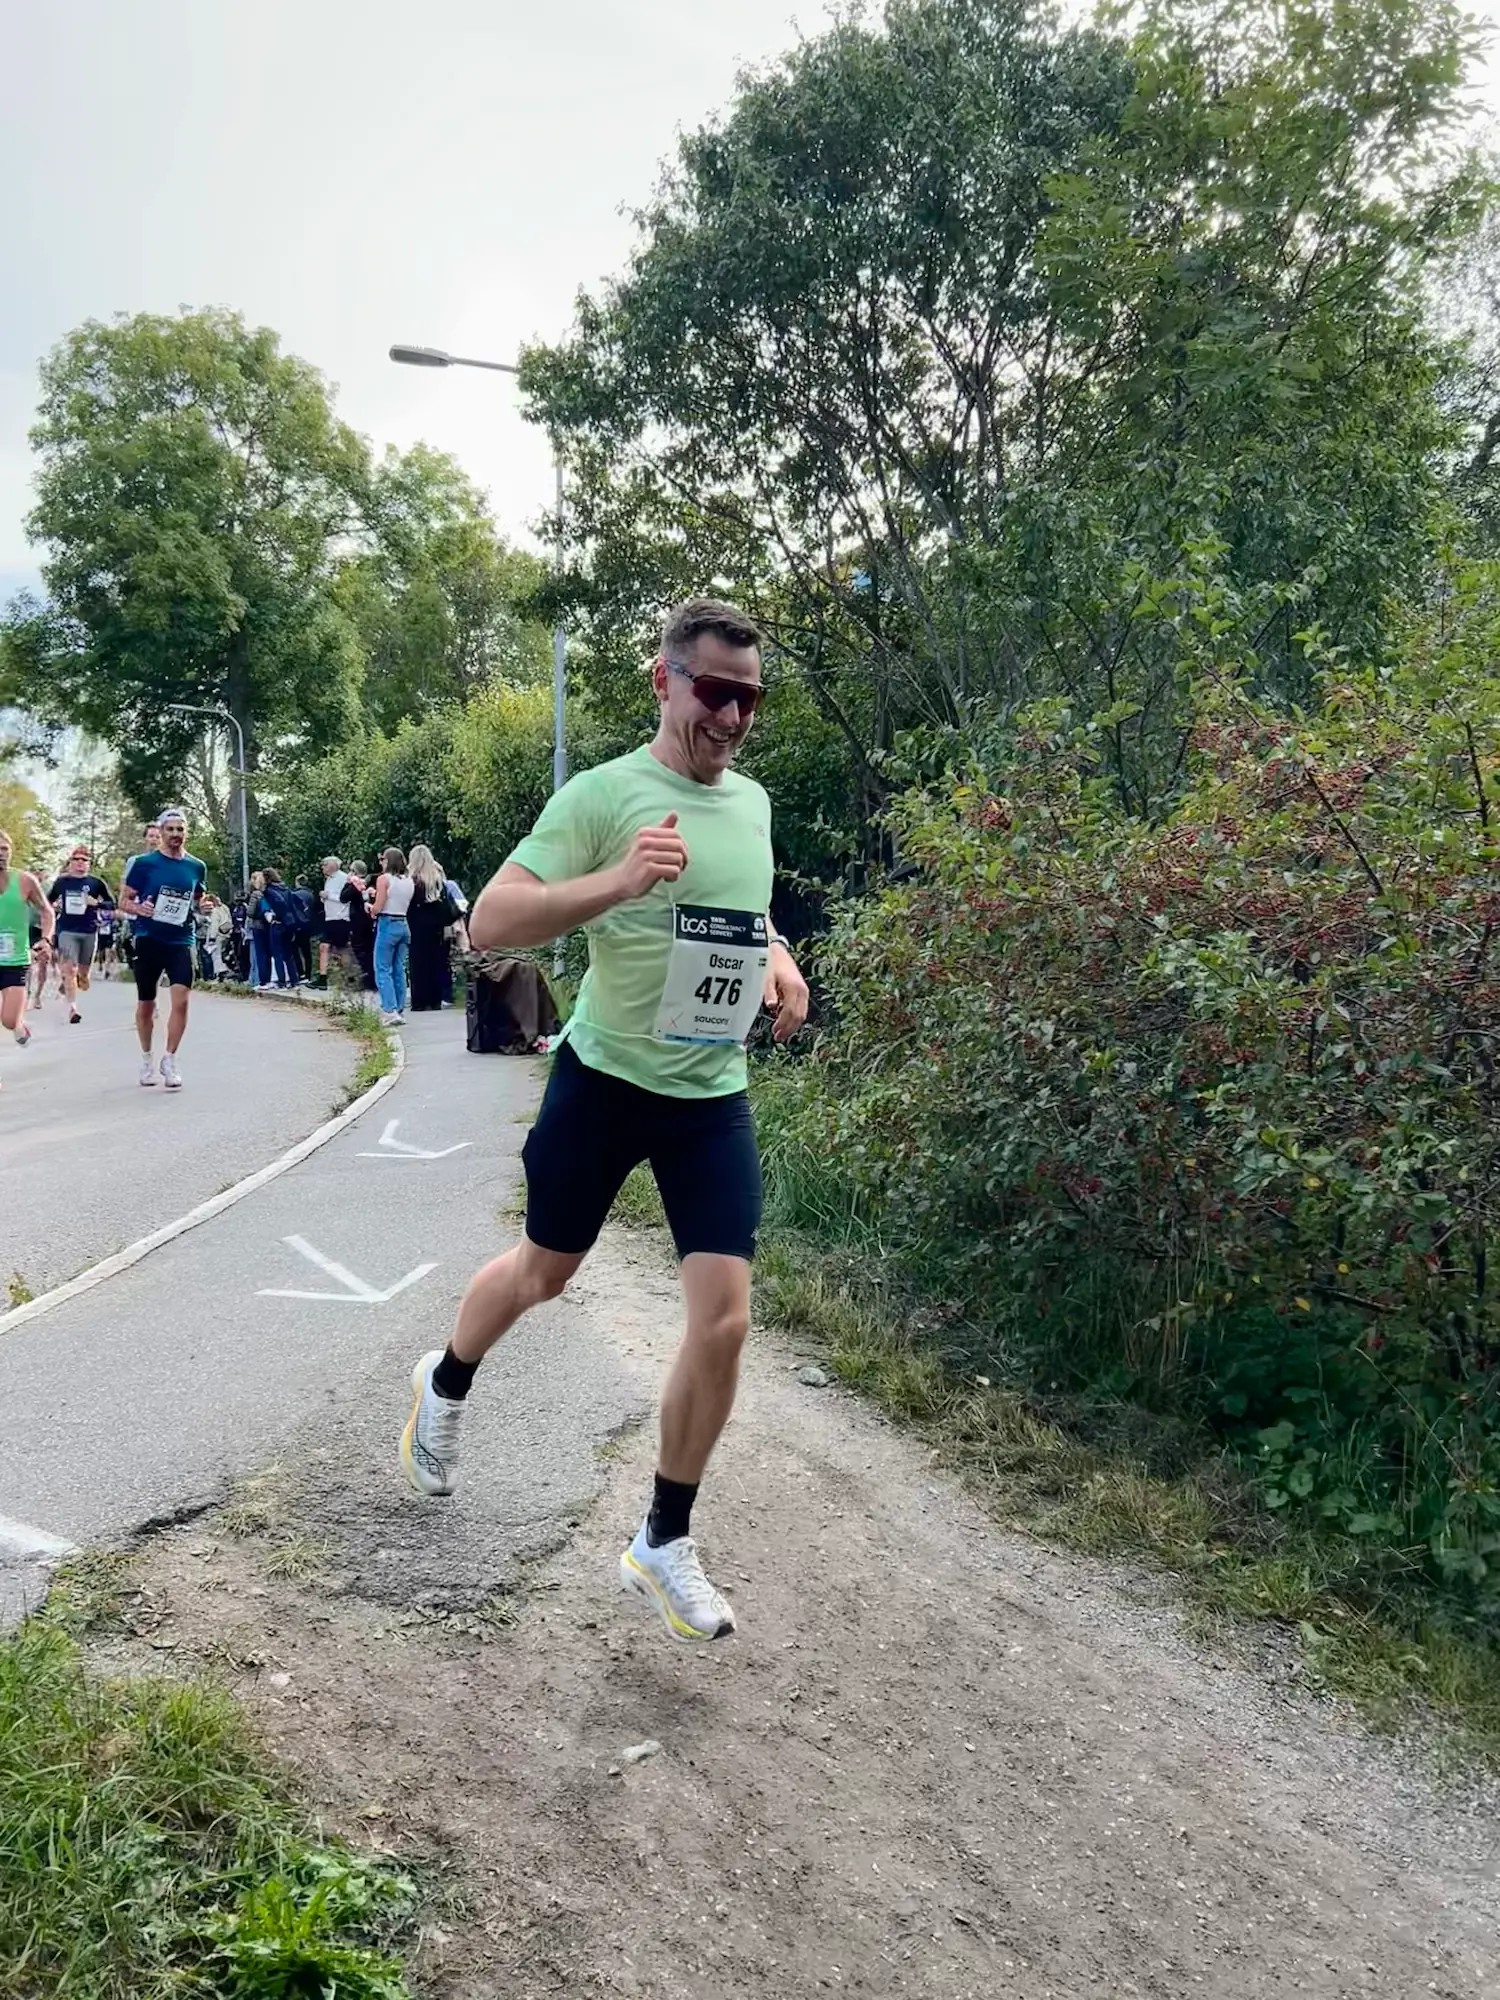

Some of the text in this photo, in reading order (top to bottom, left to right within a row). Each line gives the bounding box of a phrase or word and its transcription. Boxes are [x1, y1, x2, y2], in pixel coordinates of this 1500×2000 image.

[680, 913, 708, 934] tcs
[710, 916, 726, 924] TATA
[709, 954, 744, 970] Oscar
[694, 976, 743, 1006] 476
